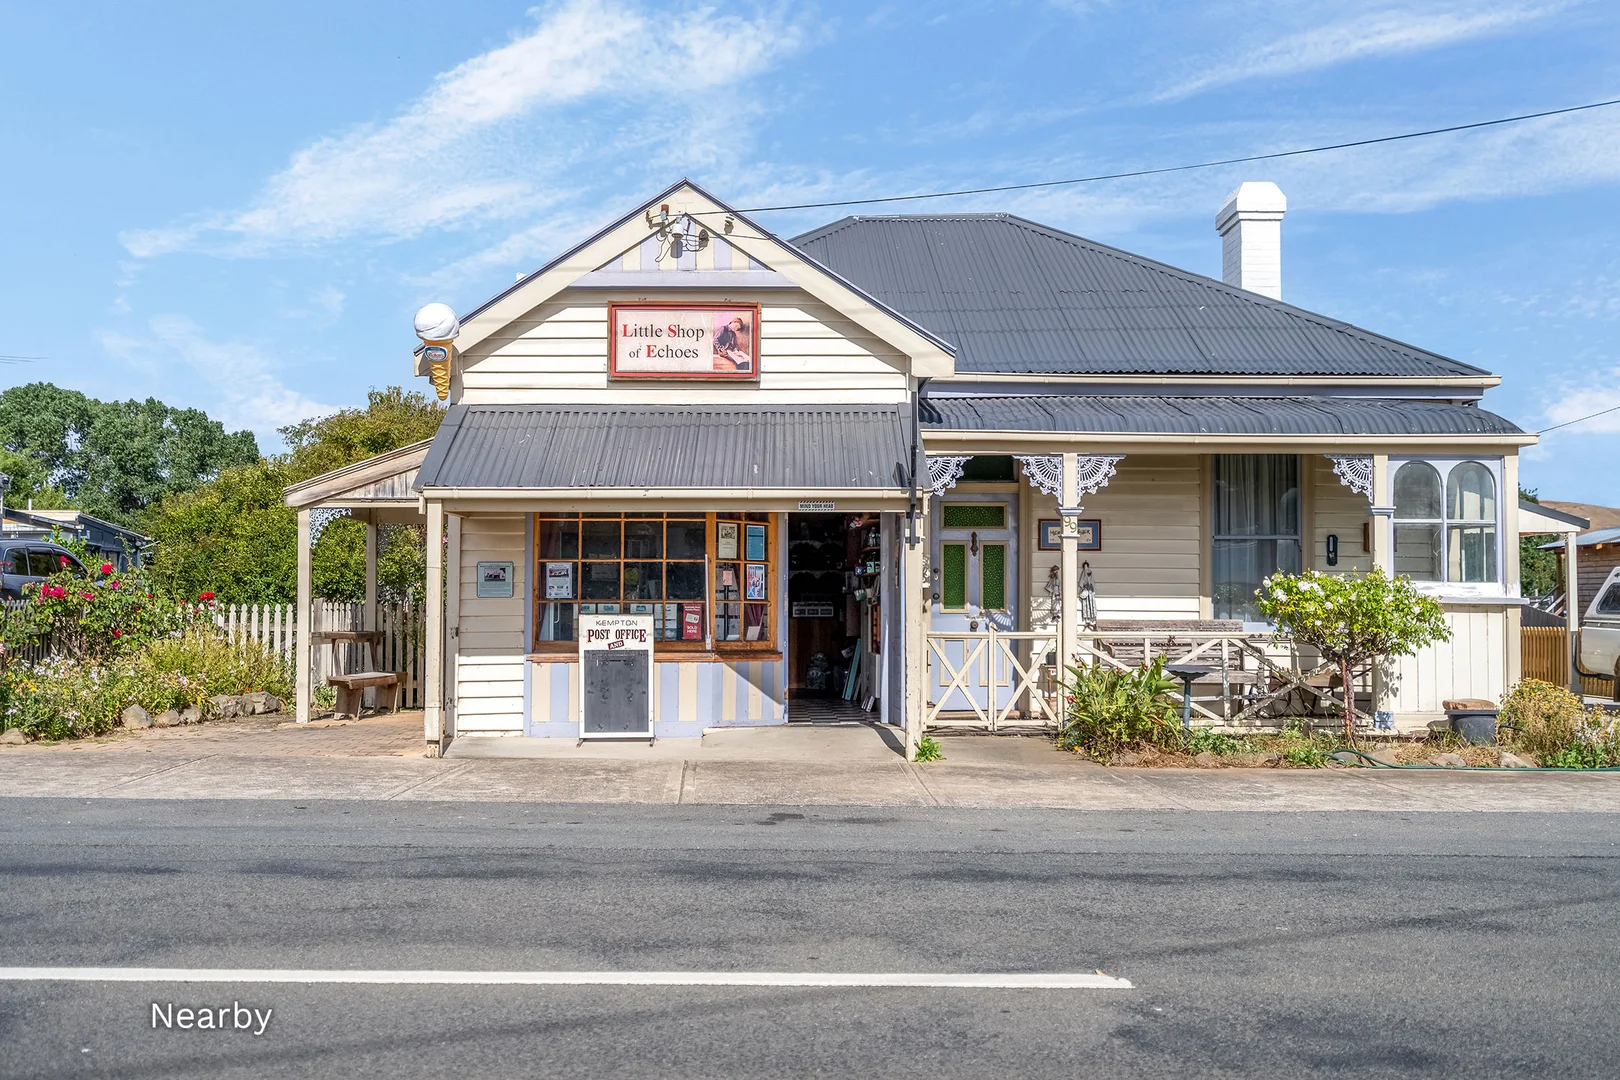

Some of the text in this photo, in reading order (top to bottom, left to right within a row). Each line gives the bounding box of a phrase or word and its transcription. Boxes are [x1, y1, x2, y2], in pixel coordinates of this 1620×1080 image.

[622, 323, 705, 342] Little Shop
[628, 344, 699, 359] of Echoes
[1063, 515, 1077, 533] 99
[595, 619, 638, 627] KEMPTON
[587, 628, 647, 643] POST OFFICE
[609, 641, 623, 649] AND
